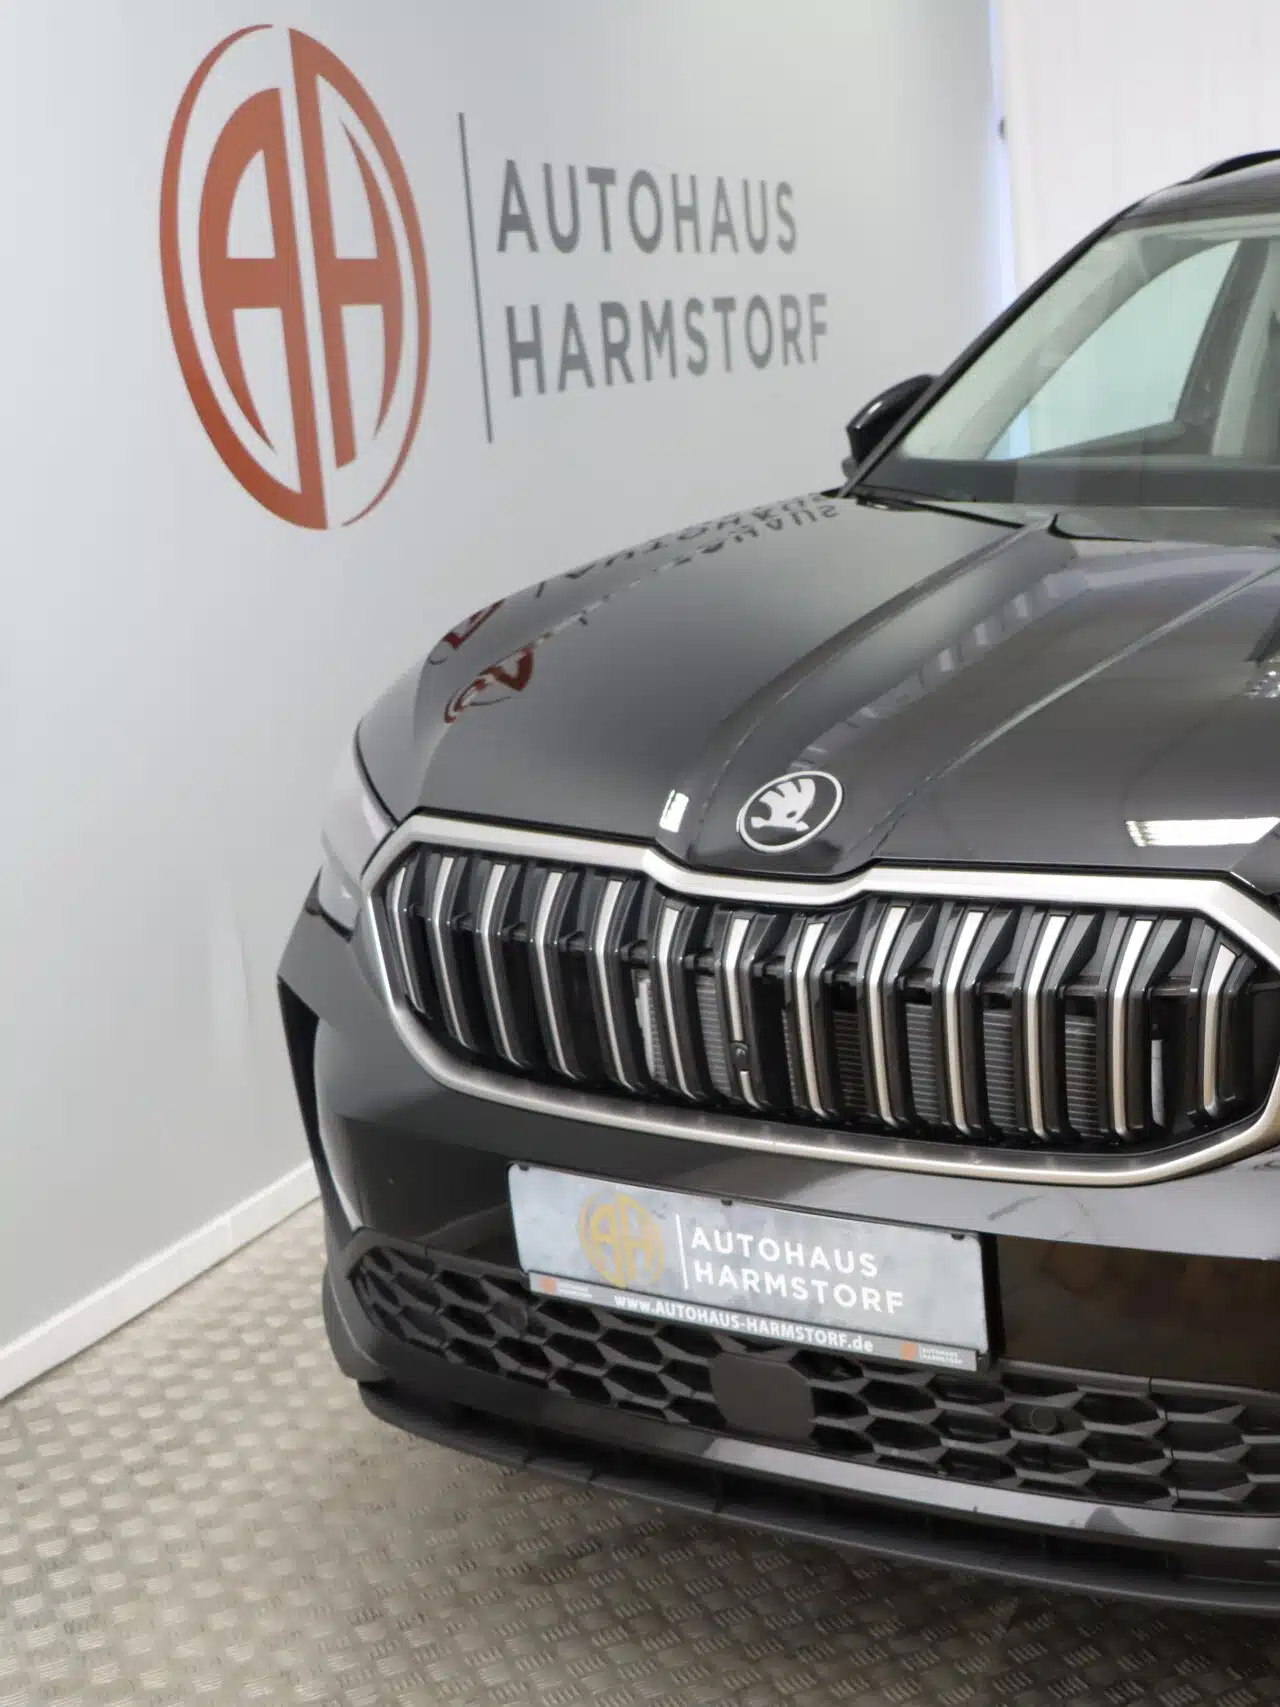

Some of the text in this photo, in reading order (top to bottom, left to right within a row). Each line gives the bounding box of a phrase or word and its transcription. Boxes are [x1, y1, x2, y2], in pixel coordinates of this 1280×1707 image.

[497, 158, 797, 255] AUTOHAUS
[505, 293, 829, 398] HARMSTORF
[690, 1226, 879, 1279] AUTOHAUS
[694, 1258, 904, 1315] HARMSTORF
[614, 1294, 874, 1353] www.AUTOHAUS-HARMSTORF.de
